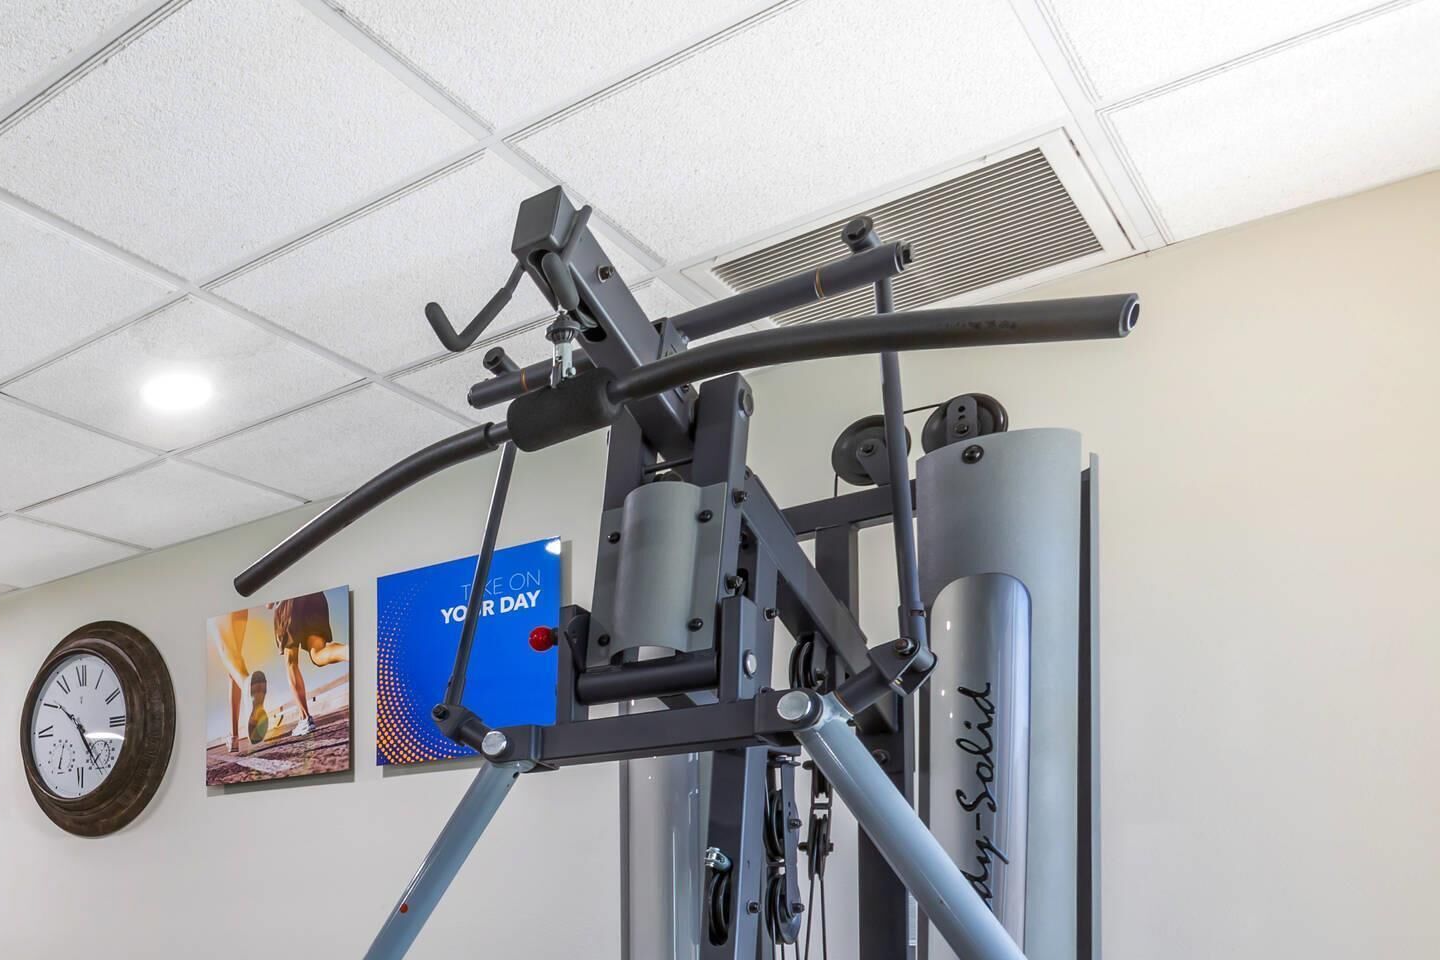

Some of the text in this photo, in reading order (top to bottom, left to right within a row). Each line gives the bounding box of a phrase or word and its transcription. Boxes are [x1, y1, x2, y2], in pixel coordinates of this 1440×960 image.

[457, 568, 541, 601] TKE ON
[440, 589, 542, 625] YOR DAY
[955, 681, 1009, 912] dy-Solid
